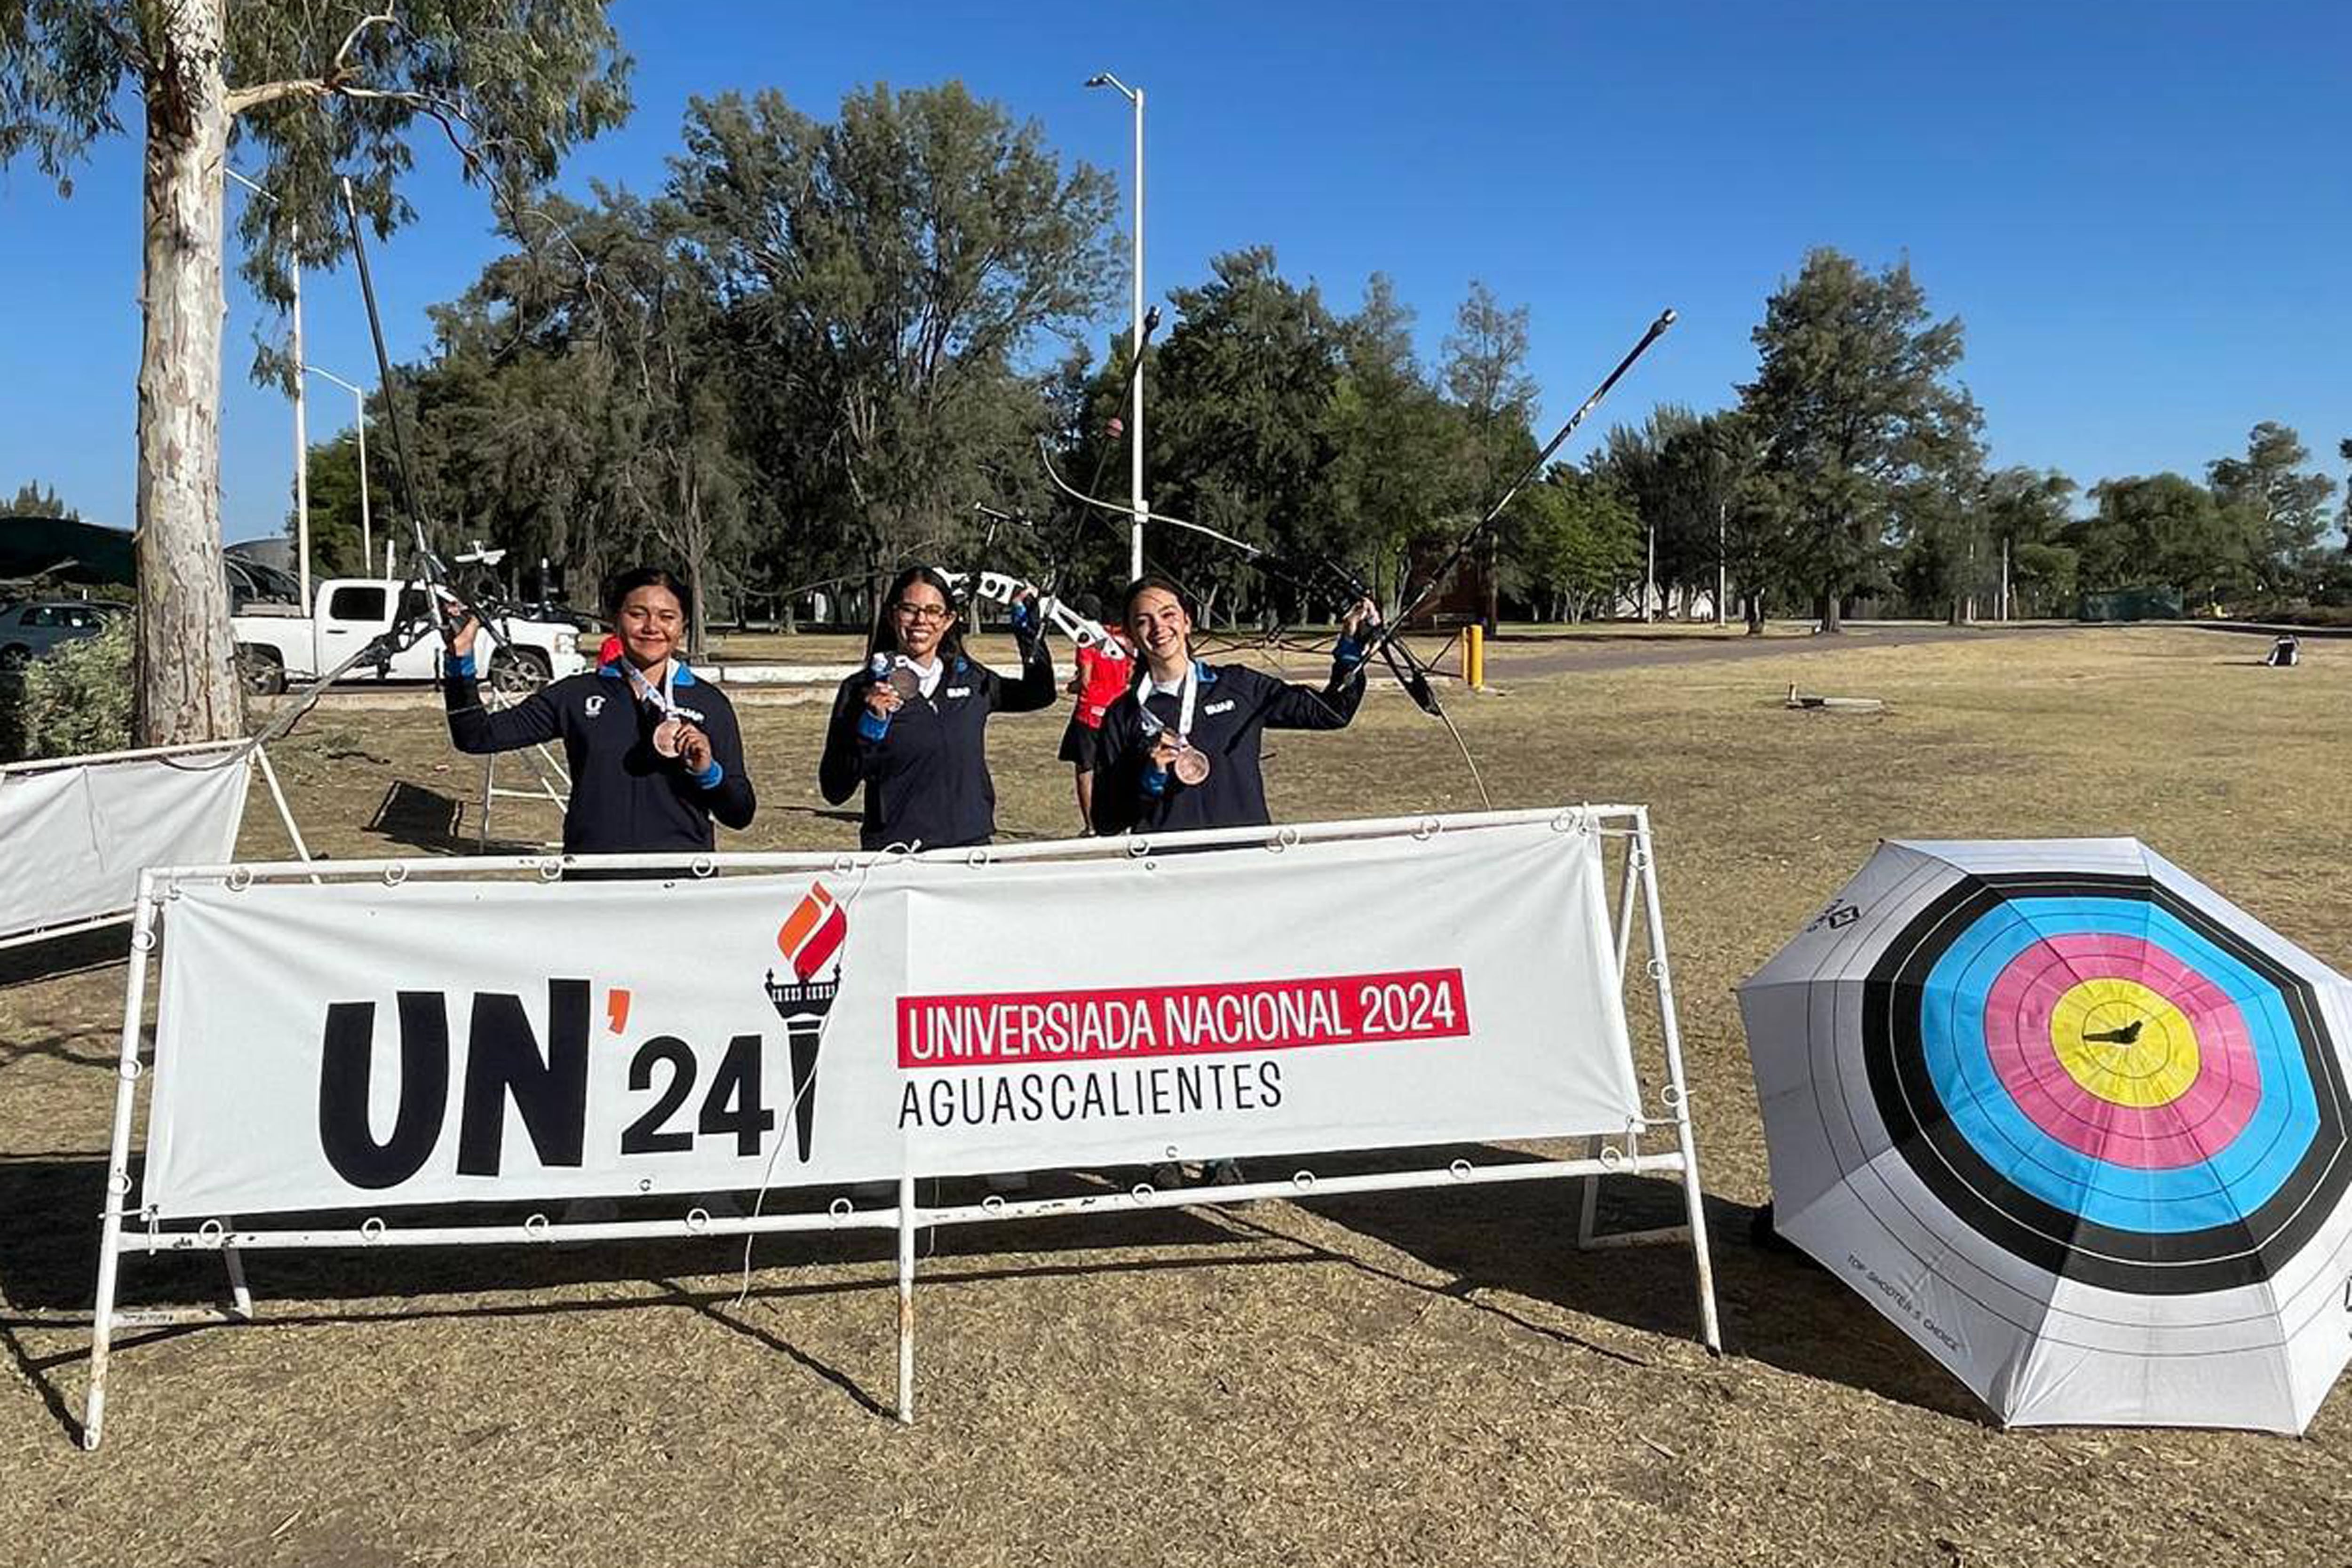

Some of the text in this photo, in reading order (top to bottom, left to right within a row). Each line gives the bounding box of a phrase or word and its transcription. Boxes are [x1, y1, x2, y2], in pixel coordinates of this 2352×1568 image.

[909, 981, 1455, 1059] UNIVERSIADA NACIONAL 2024
[898, 1061, 1281, 1129] AGUASCALIENTES
